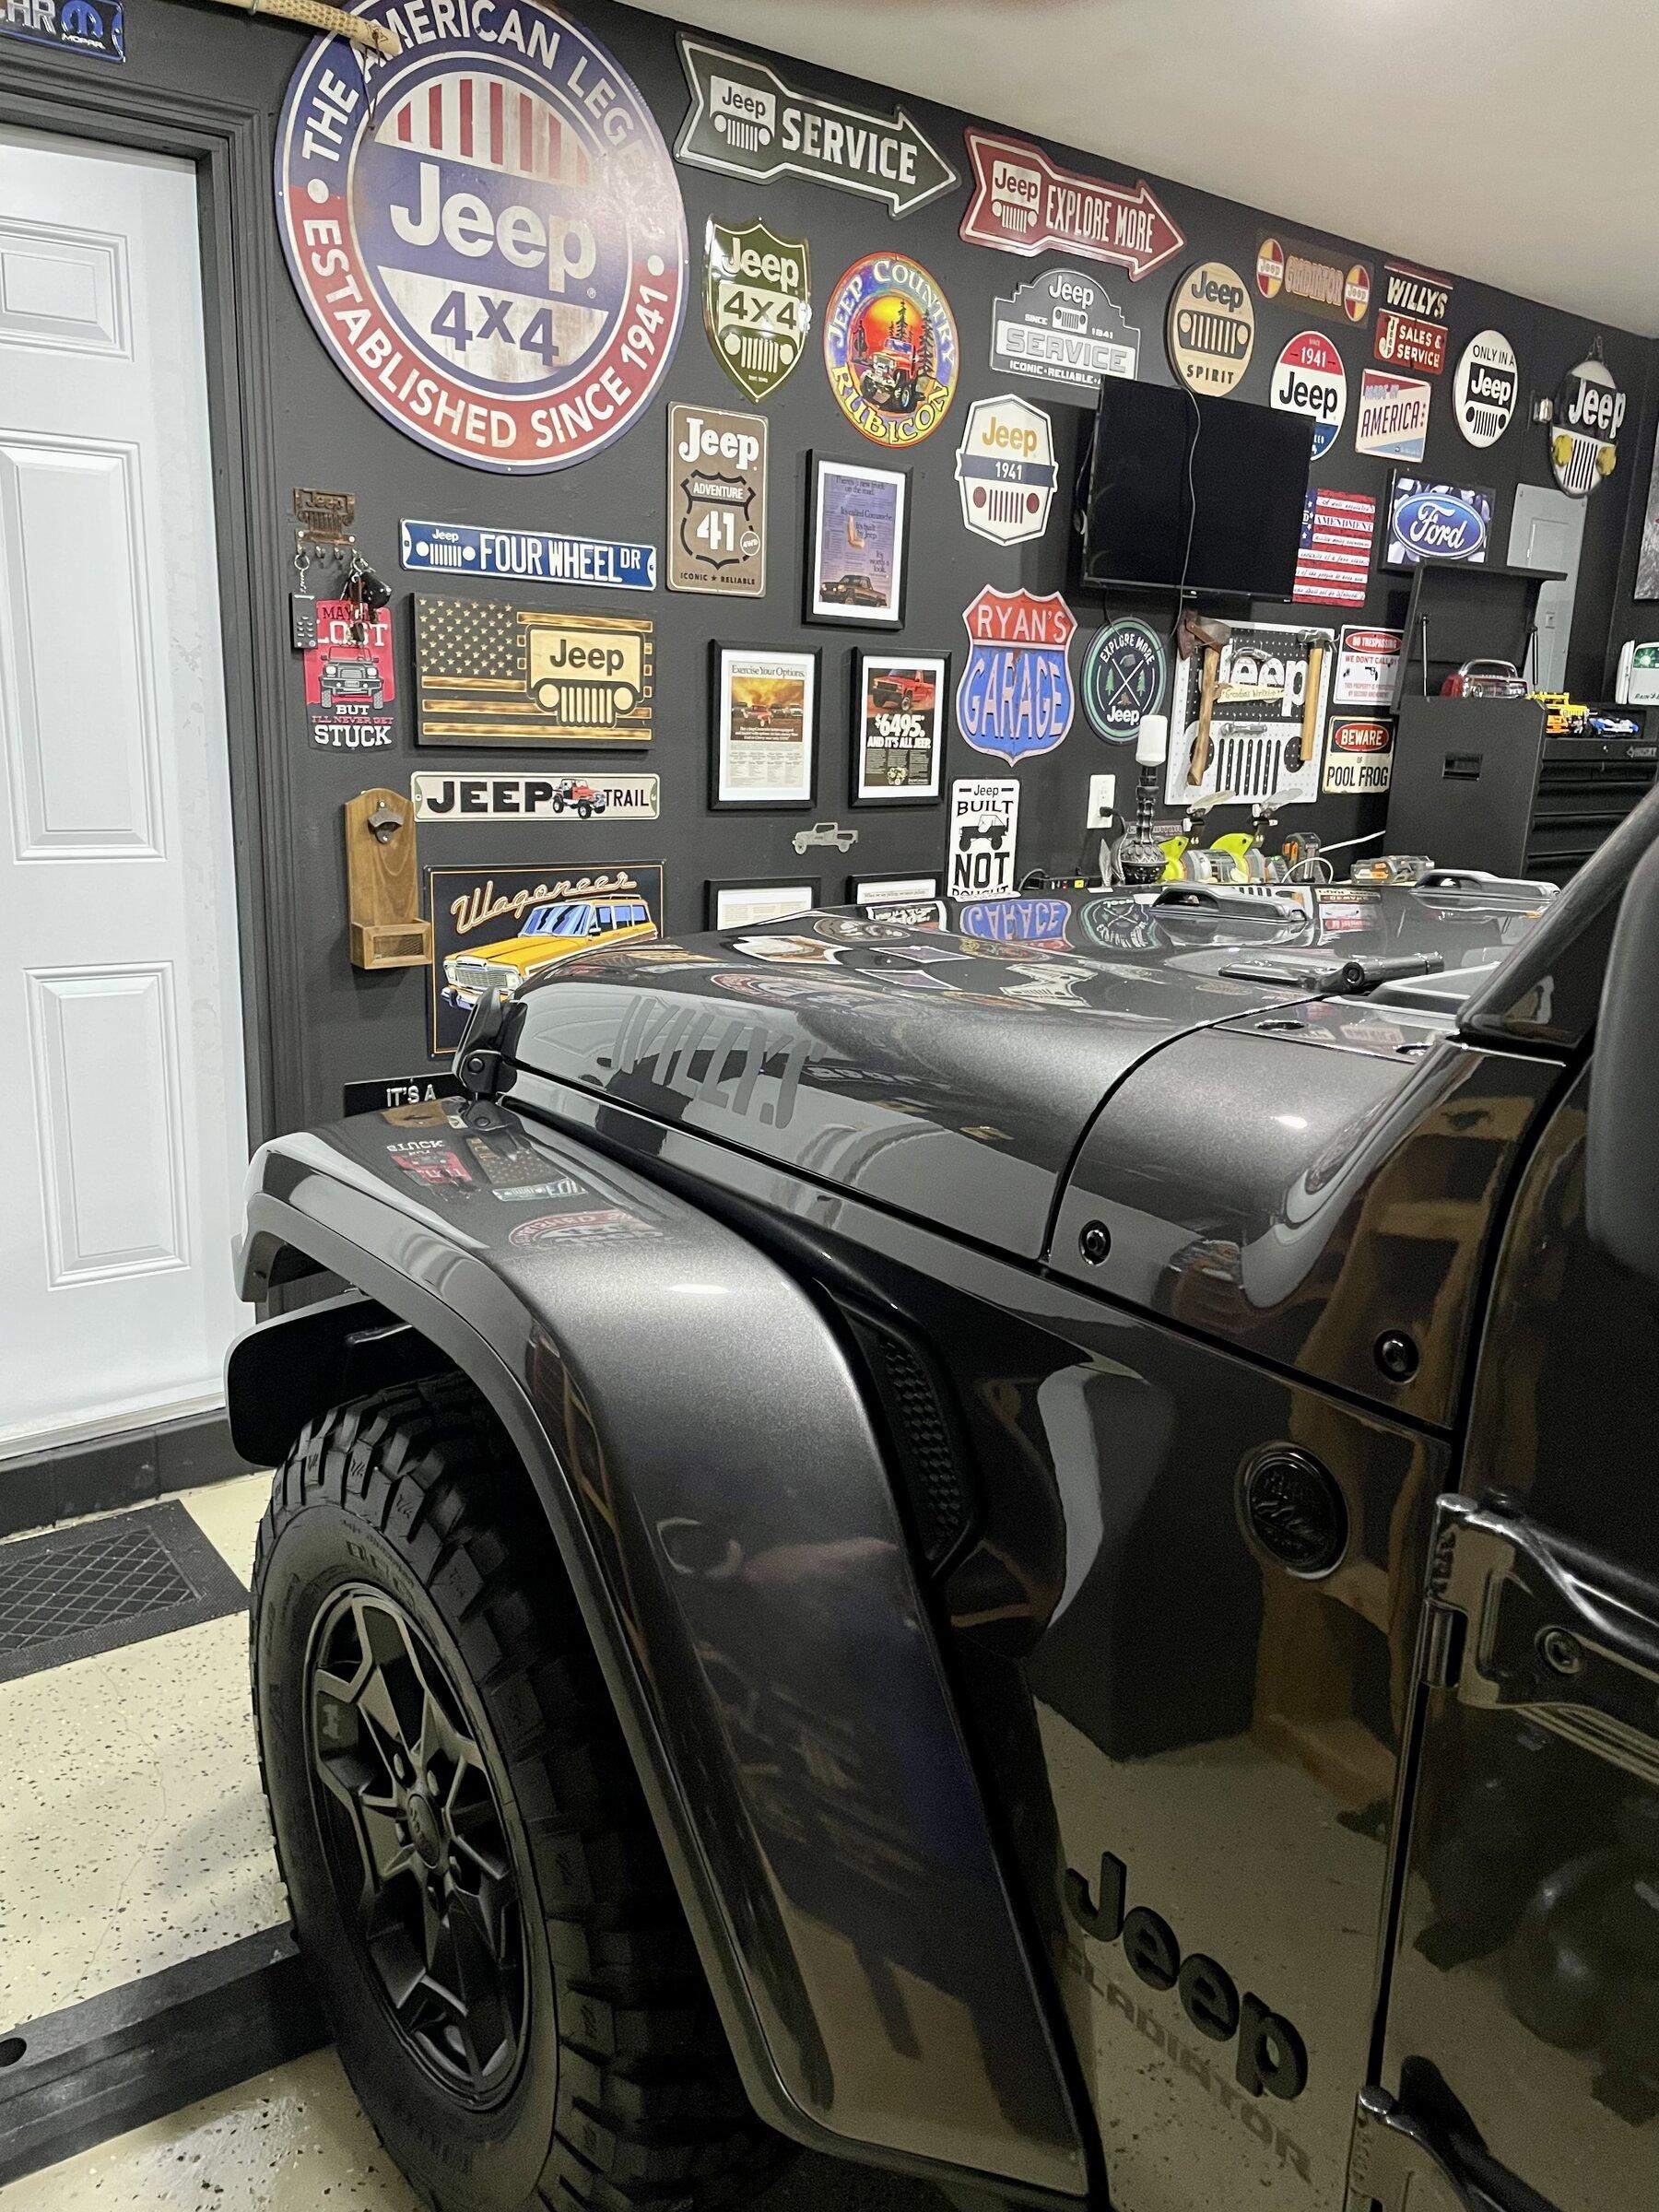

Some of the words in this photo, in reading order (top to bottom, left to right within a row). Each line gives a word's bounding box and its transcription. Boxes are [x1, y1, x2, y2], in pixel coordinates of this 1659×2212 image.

[302, 69, 362, 161] THE
[722, 86, 766, 120] Jeep
[782, 107, 918, 186] SERVICE
[391, 162, 596, 291] Jeep
[994, 168, 1040, 204] Jeep
[1046, 185, 1112, 243] EXPLORE
[1114, 206, 1156, 256] MORE
[722, 237, 800, 293] Jeep
[1260, 259, 1281, 276] Jeep
[1347, 287, 1367, 300] Jeep
[1049, 275, 1094, 310] Jeep
[1191, 270, 1244, 312] Jeep
[1387, 276, 1448, 319] WILLYS
[829, 275, 863, 347] JEEP
[873, 261, 955, 365] COUNTRY
[306, 219, 517, 448] ESTABLISHED
[531, 367, 633, 448] SINCE
[621, 285, 669, 371] 1941
[1091, 327, 1113, 339] 1941
[1399, 325, 1431, 347] SALES
[1435, 335, 1441, 349] &
[1006, 327, 1127, 373] SERVICE
[1301, 347, 1326, 368] 1941
[1396, 344, 1440, 368] SERVICE
[1473, 345, 1498, 361] ONLY
[1498, 351, 1507, 363] IN
[1508, 355, 1514, 367] A
[1009, 360, 1043, 375] ICONIC
[1048, 368, 1093, 384] RELIABLE
[1186, 363, 1235, 385] SPIRIT
[1470, 368, 1512, 406] Jeep
[832, 365, 948, 444] RUBICON
[1279, 371, 1337, 419] Jeep
[1569, 378, 1627, 440] Jeep
[1361, 401, 1419, 438] AMERICA
[678, 417, 759, 471] Jeep
[982, 417, 1039, 458] Jeep
[994, 461, 1024, 481] 1941
[304, 495, 346, 511] Jeep
[692, 481, 744, 500] ADVENTURE
[696, 511, 735, 552] 41
[1316, 516, 1371, 532] AMENDMENT
[1411, 500, 1469, 550] Ford
[432, 528, 459, 543] Jeep
[478, 534, 542, 575] FOUR
[548, 540, 623, 582] WHEEL
[620, 552, 641, 570] DR
[742, 536, 759, 549] 4WD
[679, 572, 709, 583] ICONIC
[720, 575, 757, 587] RELIABLE
[323, 606, 351, 620] MAY
[977, 603, 1067, 644] RYAN'S
[316, 620, 388, 647] LOT
[1100, 633, 1135, 664] EXPLORE
[1135, 635, 1155, 665] MORE
[1361, 637, 1397, 649] TRESPASSING
[549, 640, 625, 677] Jeep
[732, 665, 759, 676] Exercise
[759, 666, 775, 676] Your
[1357, 655, 1373, 664] DON'T
[336, 704, 370, 716] BUT
[967, 652, 1064, 740] GARAGE
[334, 715, 371, 724] NEVER
[372, 716, 394, 725] GET
[1107, 706, 1139, 725] Jeep
[314, 724, 393, 748] STUCK
[867, 736, 885, 747] AND
[885, 736, 900, 748] IT'S
[899, 737, 912, 748] ALL
[1341, 729, 1383, 746] BEWARE
[973, 784, 999, 798] Jeep
[1327, 767, 1356, 787] POOL
[1359, 767, 1388, 787] FROG
[427, 781, 553, 813] JEEP
[603, 788, 650, 807] TRAIL
[957, 800, 1014, 817] BUILT
[954, 853, 1010, 888] NOT
[450, 870, 638, 935] Wagoneer
[386, 1086, 418, 1107] IT'S
[424, 1084, 437, 1101] A
[1065, 1851, 1309, 2101] Jeep
